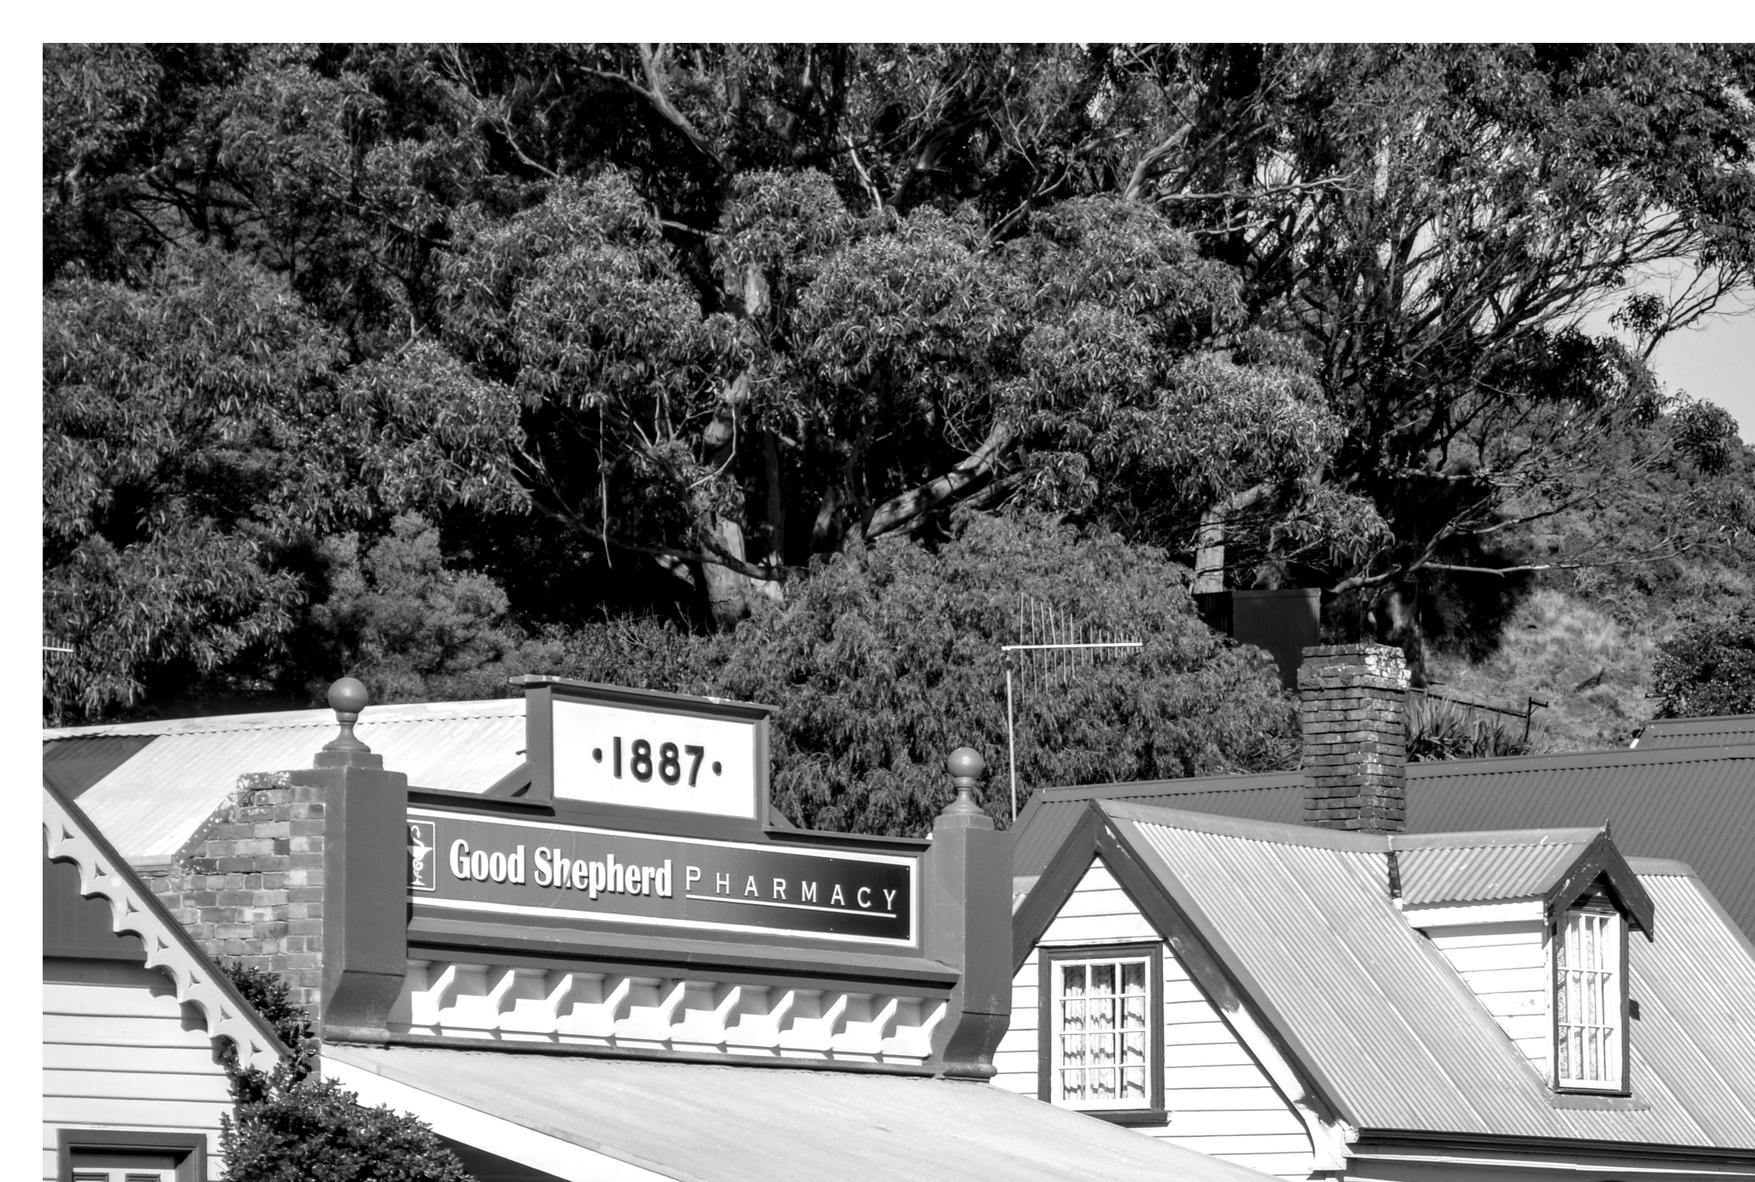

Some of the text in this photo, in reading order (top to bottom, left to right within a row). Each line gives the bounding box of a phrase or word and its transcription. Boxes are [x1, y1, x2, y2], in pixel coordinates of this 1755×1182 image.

[612, 735, 705, 788] 1887
[448, 838, 897, 911] Good Shepherd PHARMACY
